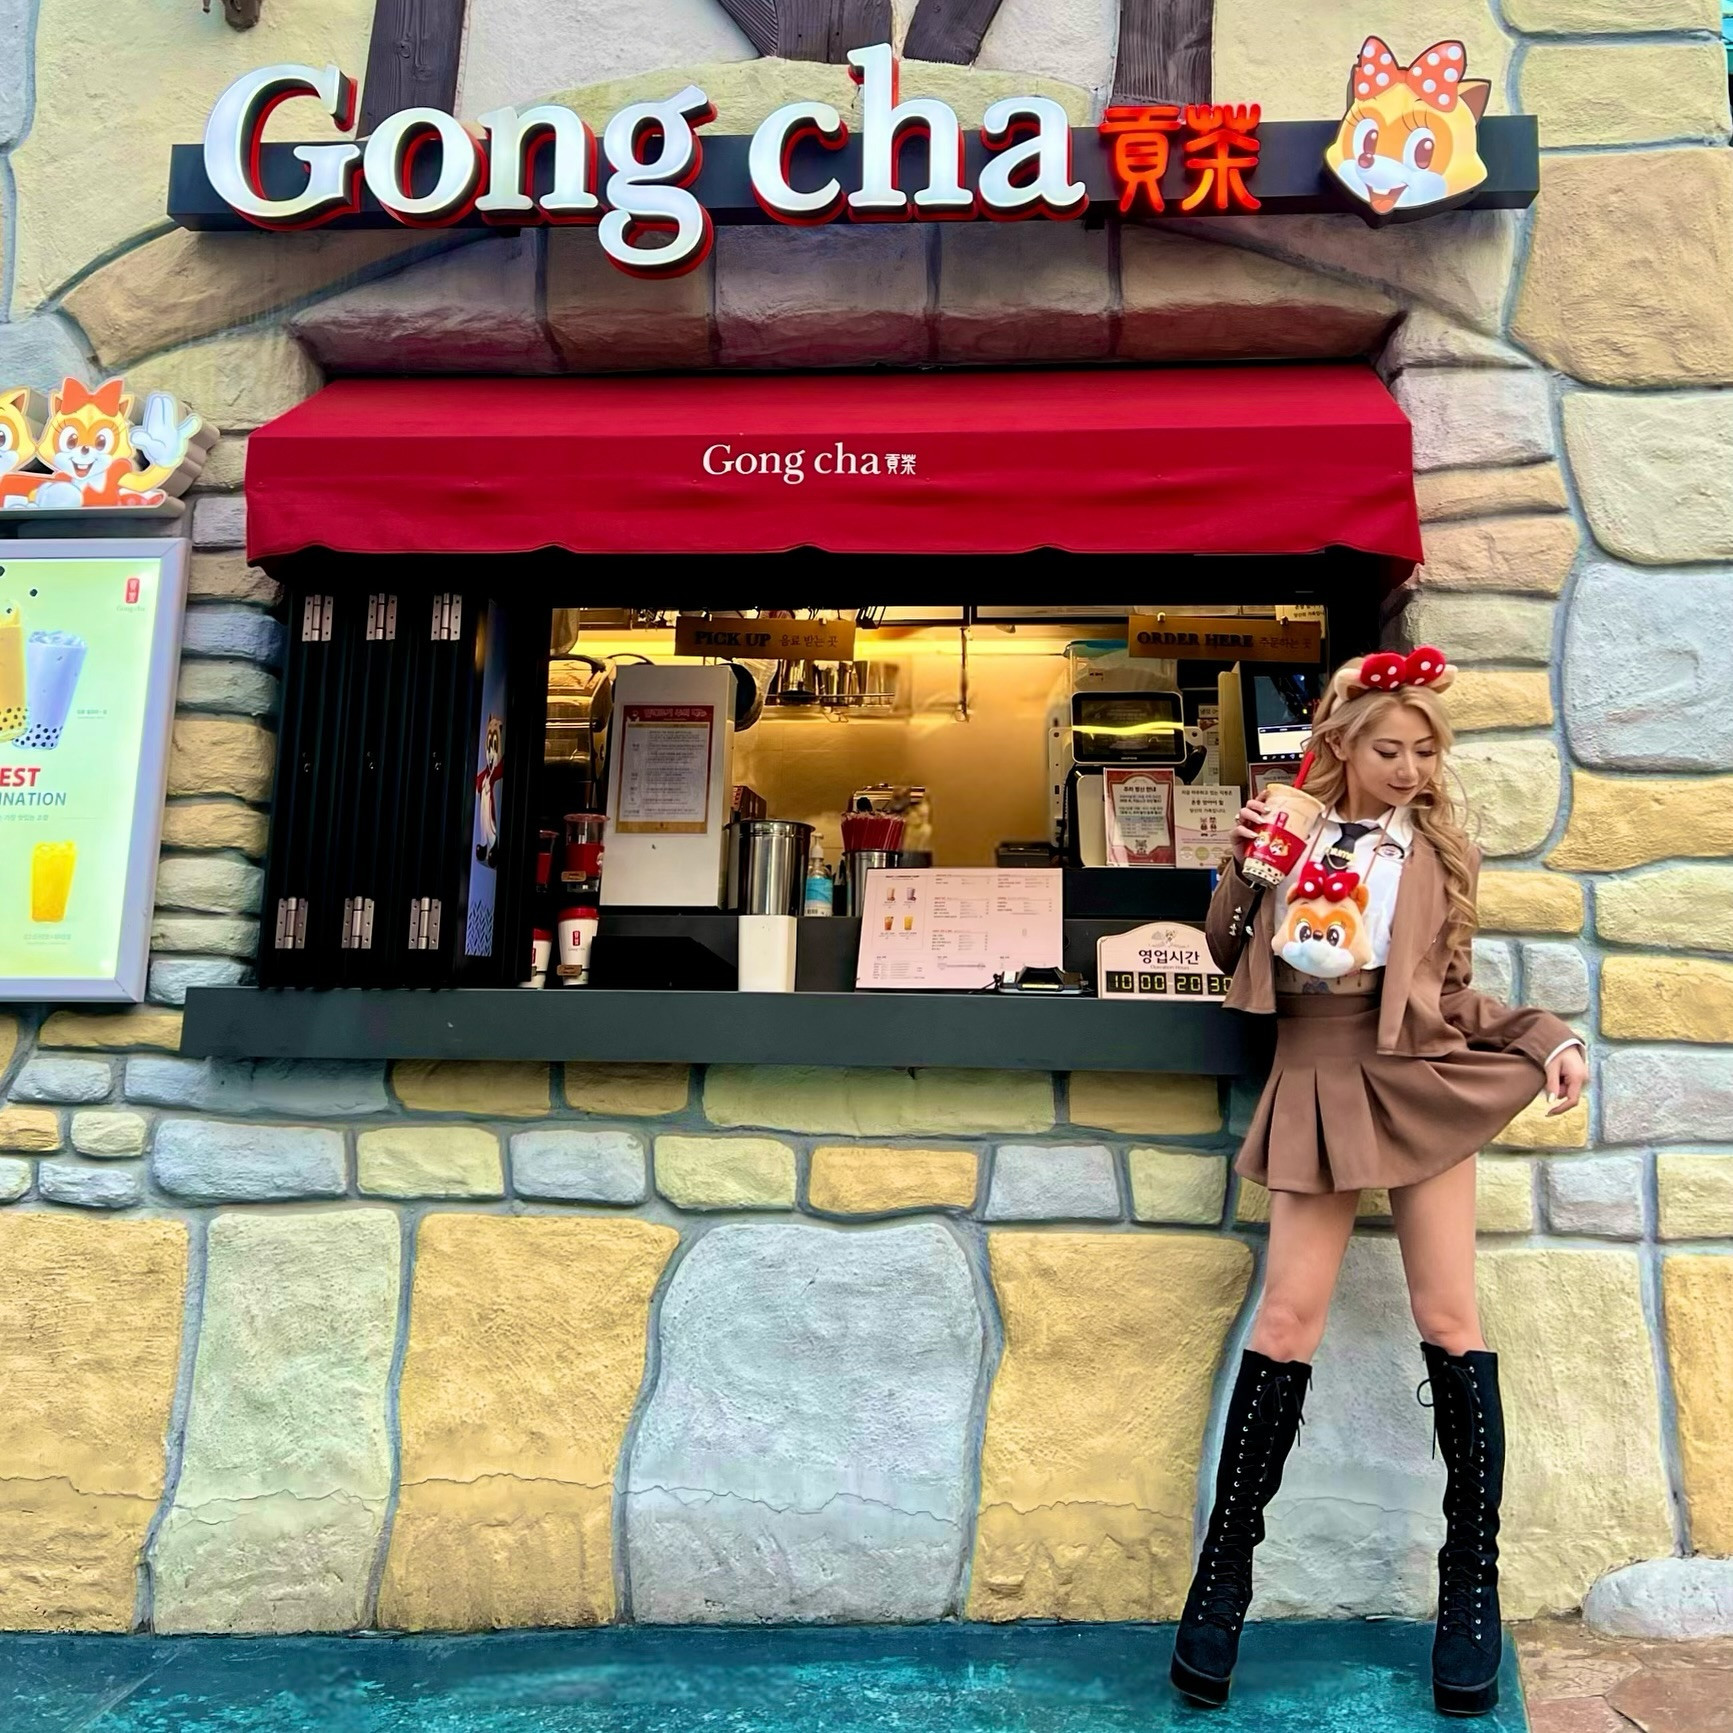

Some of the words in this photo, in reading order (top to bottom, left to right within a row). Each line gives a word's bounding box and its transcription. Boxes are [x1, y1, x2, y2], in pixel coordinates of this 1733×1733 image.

[203, 63, 712, 272] Gong
[749, 42, 1086, 216] cha
[703, 443, 806, 485] Gong
[813, 441, 882, 475] cha
[695, 631, 741, 647] PICK
[745, 633, 772, 648] UP
[780, 634, 800, 647] 음료
[804, 635, 824, 648] 받는
[828, 636, 839, 648] 곳
[1137, 631, 1200, 646] ORDER
[1205, 633, 1254, 648] HERE
[1138, 949, 1200, 965] 영업시간
